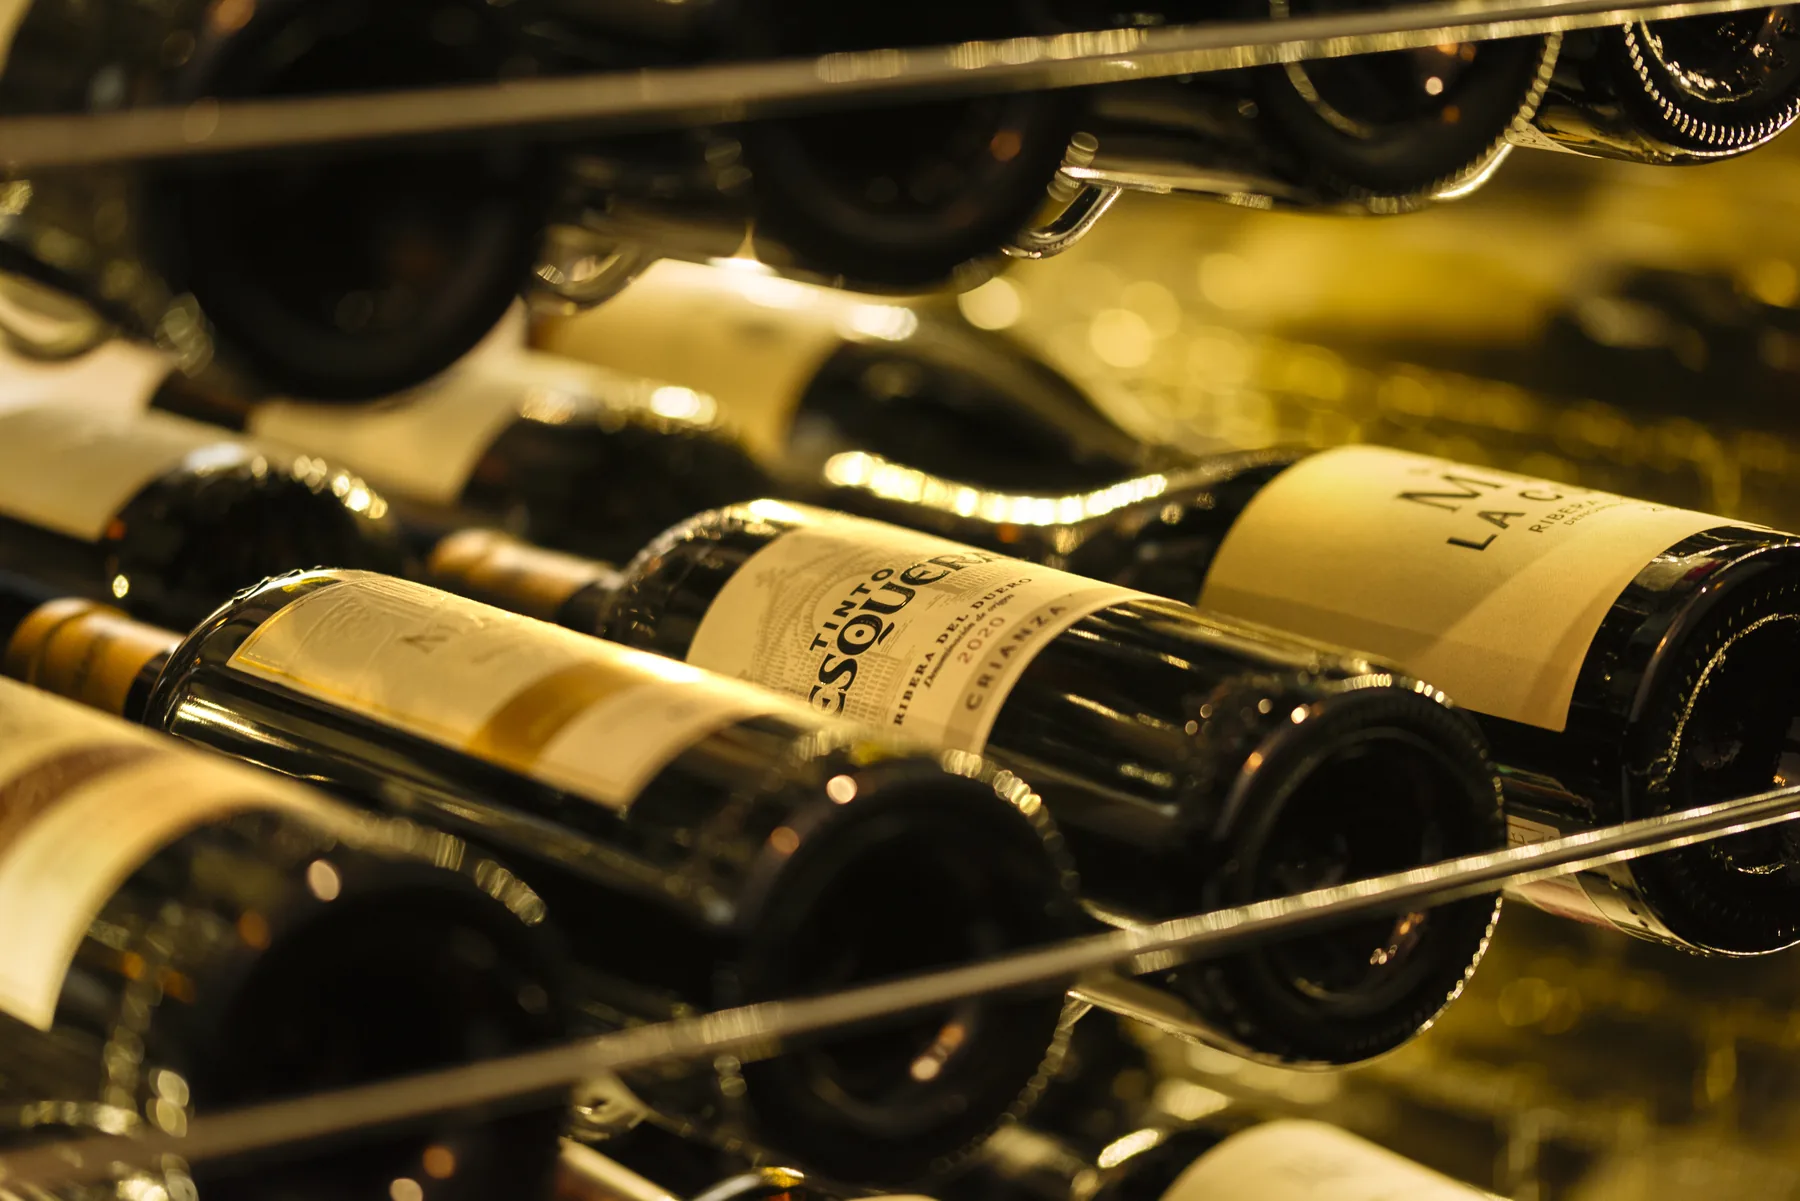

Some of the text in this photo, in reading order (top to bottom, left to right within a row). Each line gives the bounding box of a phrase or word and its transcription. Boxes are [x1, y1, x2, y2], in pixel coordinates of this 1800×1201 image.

[1446, 509, 1527, 552] LA
[1528, 499, 1600, 533] RIBERA
[808, 551, 1001, 717] ESQUERA
[809, 567, 894, 653] TINTO
[893, 578, 1033, 726] RIBERA DEL DUERO
[957, 616, 1006, 665] 2020
[965, 605, 1068, 712] CRIANZA
